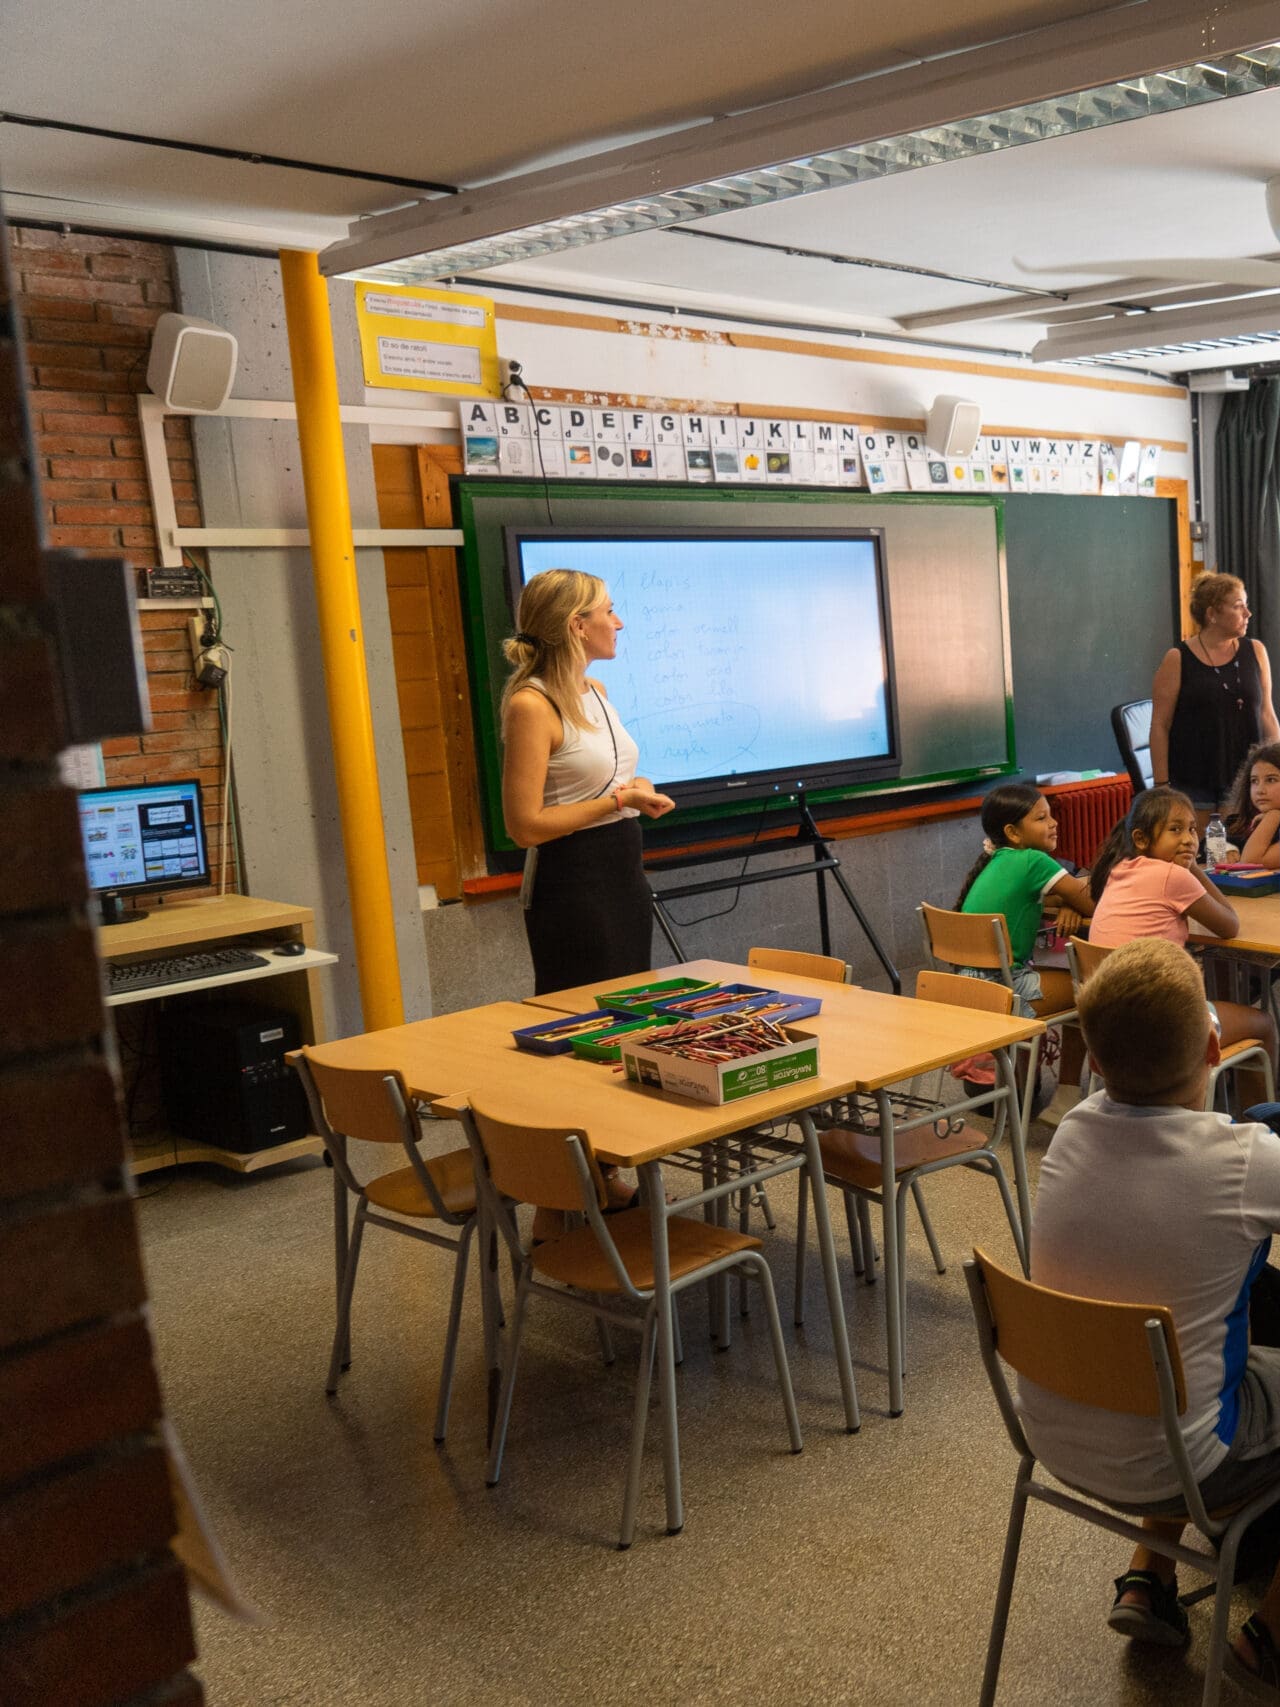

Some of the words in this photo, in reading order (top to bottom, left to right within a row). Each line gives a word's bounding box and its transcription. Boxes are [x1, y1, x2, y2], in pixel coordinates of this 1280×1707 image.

[471, 404, 487, 422] A
[504, 407, 520, 424] B
[570, 411, 584, 427] D
[602, 413, 615, 428] E
[633, 414, 643, 430] F
[660, 416, 674, 431] G
[689, 418, 702, 433] H
[720, 420, 726, 435] I
[745, 422, 754, 436] J
[770, 423, 782, 438] K
[796, 424, 806, 439] L
[819, 426, 832, 440] M
[842, 428, 854, 441] N
[865, 436, 876, 450] O
[886, 435, 895, 448] P
[908, 436, 919, 447] Q
[991, 440, 1000, 452] U
[1011, 440, 1019, 453] V
[1029, 441, 1041, 453] W
[1048, 443, 1057, 455] X
[1066, 443, 1074, 456] Y
[1084, 443, 1093, 457] Z
[756, 1065, 766, 1075] 80
